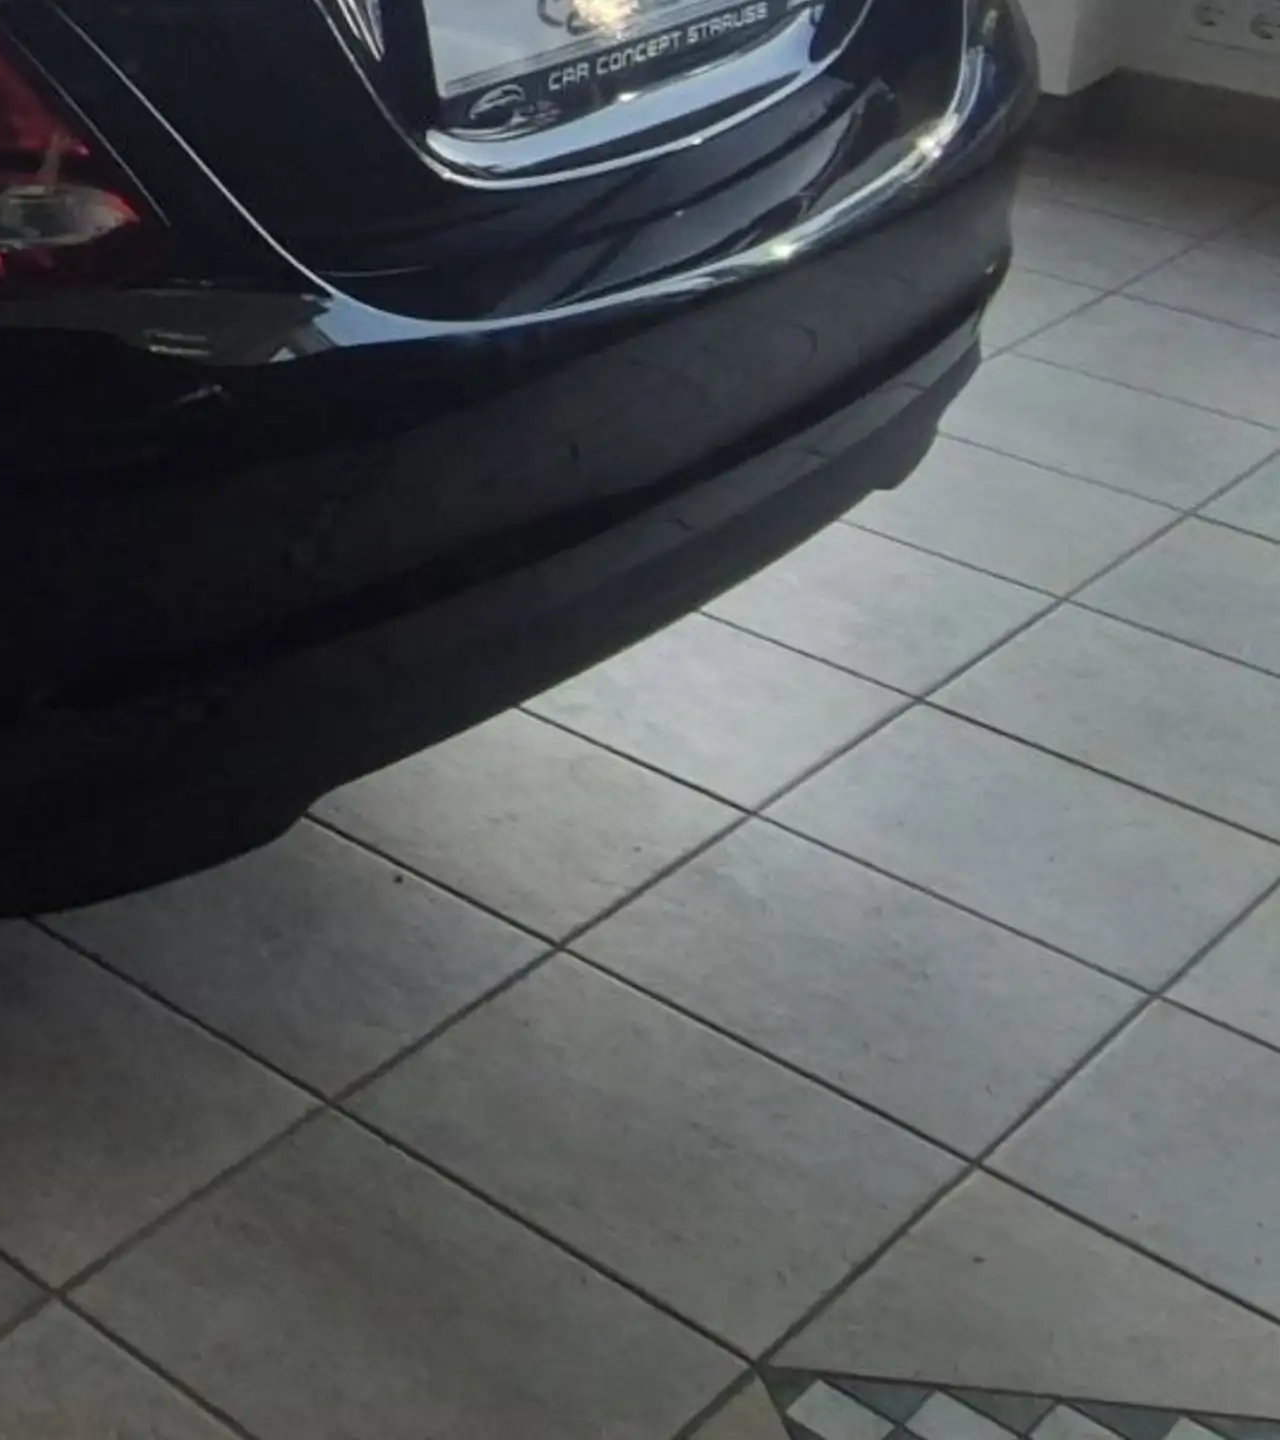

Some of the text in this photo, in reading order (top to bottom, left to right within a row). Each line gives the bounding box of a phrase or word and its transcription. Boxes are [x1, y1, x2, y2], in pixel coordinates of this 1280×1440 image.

[548, 1, 768, 92] CAR CONCEPT STRAUSS
